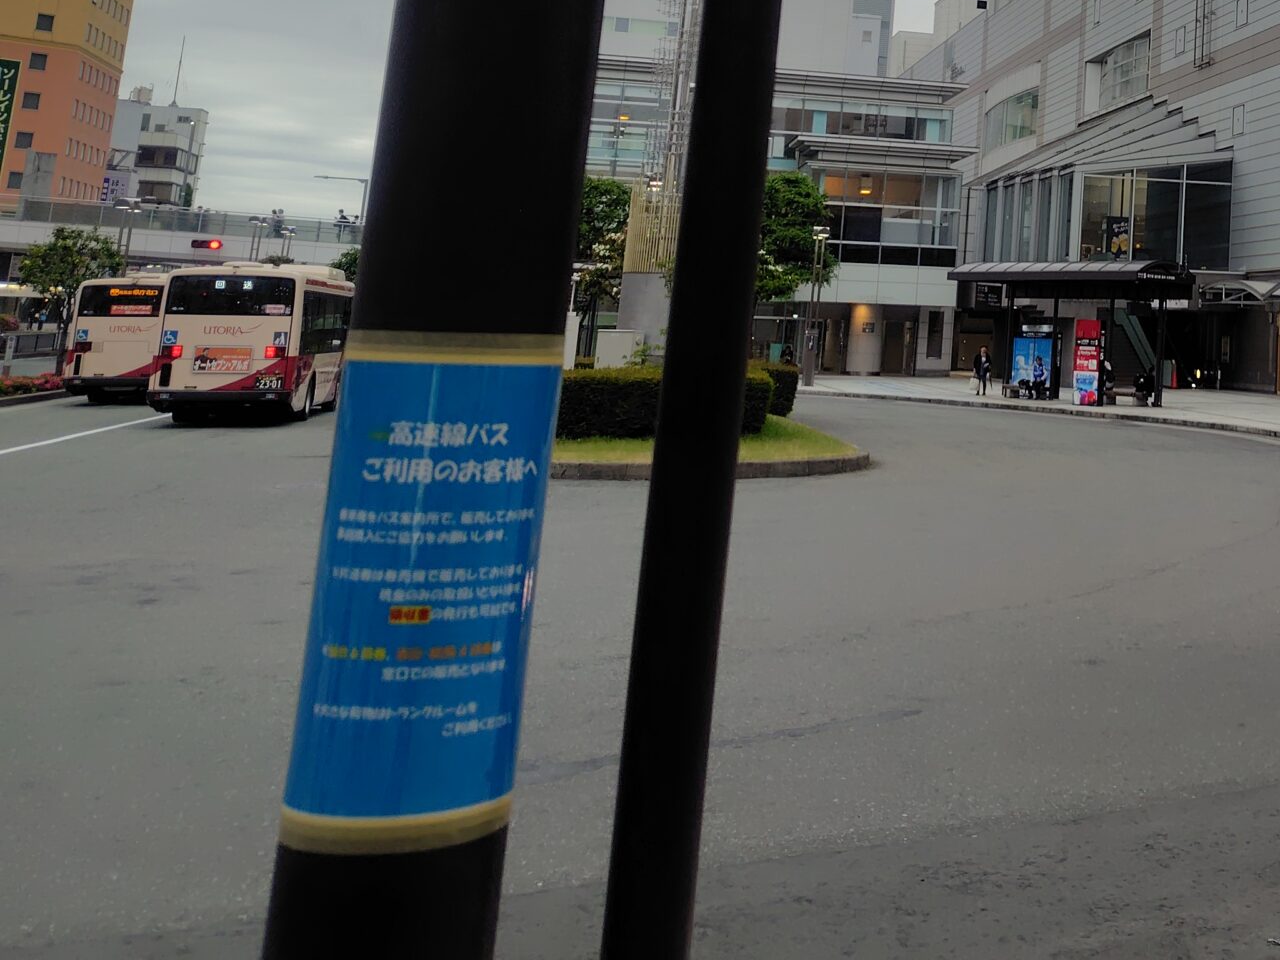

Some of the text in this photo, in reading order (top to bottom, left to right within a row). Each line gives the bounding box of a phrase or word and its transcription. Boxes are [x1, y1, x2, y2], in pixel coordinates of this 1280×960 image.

[203, 325, 242, 336] UTORIA
[389, 421, 510, 447] 高速線バス
[362, 457, 538, 483] ご利用のお客様へ
